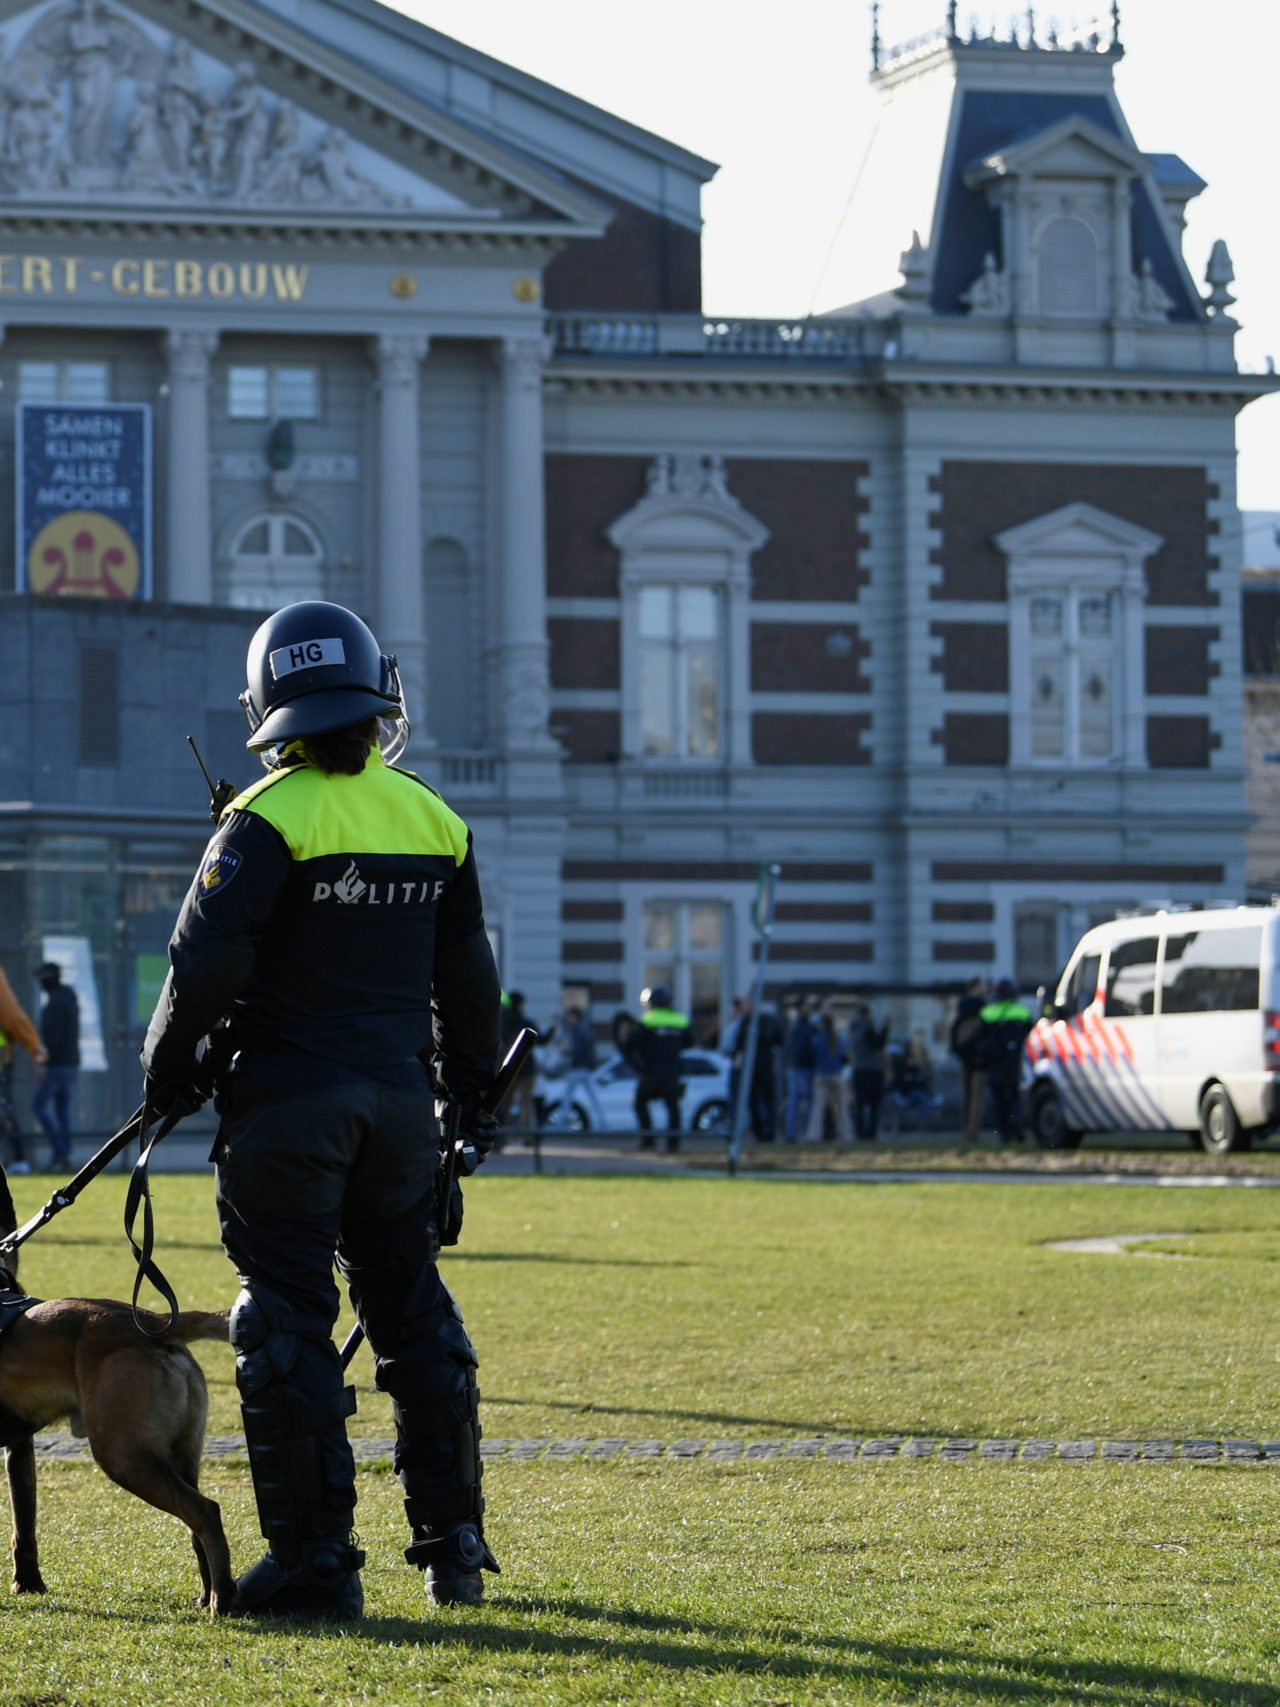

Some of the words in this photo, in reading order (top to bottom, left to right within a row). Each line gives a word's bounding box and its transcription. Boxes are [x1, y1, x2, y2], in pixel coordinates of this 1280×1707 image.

[44, 414, 124, 438] SAMEN
[44, 438, 122, 460] KLINKT
[50, 462, 117, 484] ALLES
[36, 485, 131, 509] MOOIER
[288, 642, 324, 668] HG
[312, 880, 445, 904] PLITIE
